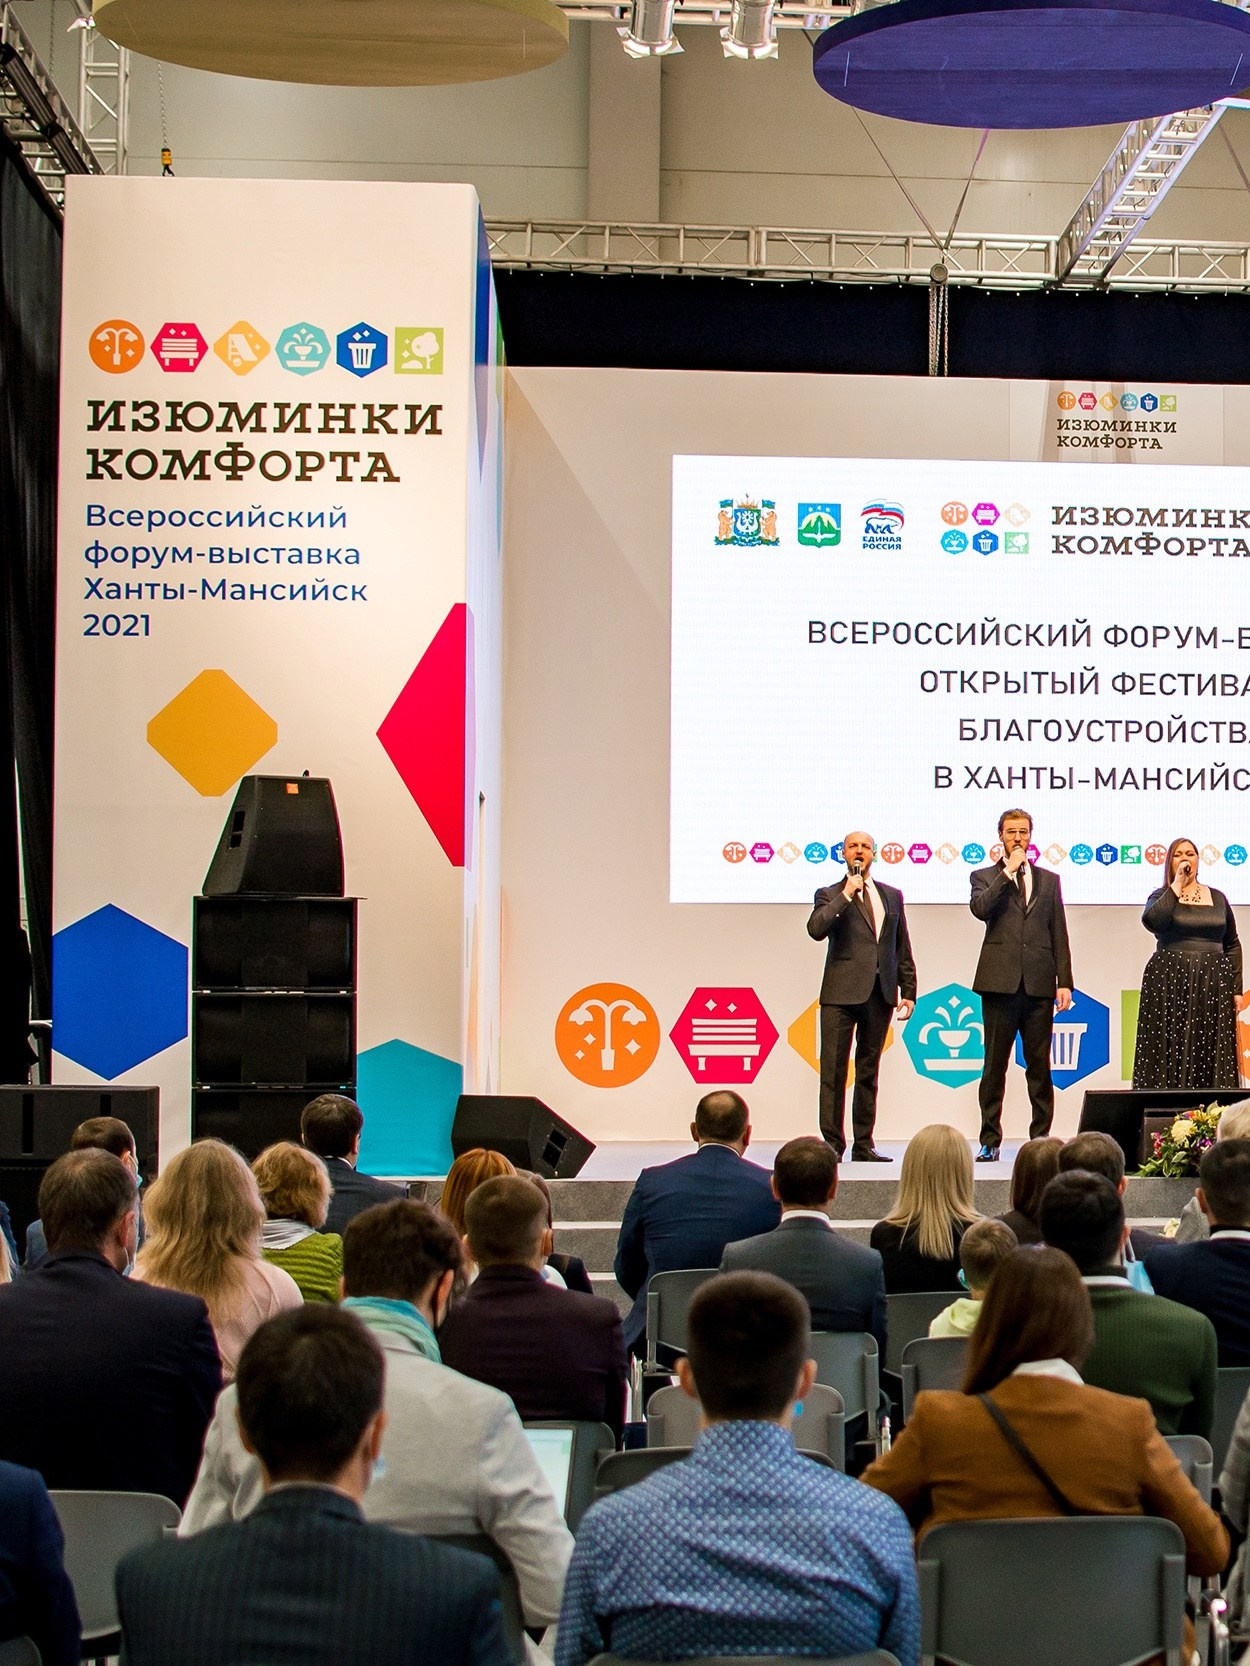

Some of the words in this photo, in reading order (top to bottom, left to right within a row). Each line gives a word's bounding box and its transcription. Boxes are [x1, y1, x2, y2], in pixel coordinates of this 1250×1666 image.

[86, 399, 443, 436] ИЗЮМИНКИ
[1056, 418, 1177, 434] ИЗЮМИНКИ
[1056, 433, 1164, 450] КОМФОРТА
[85, 441, 401, 483] КОМФОРТА
[86, 504, 346, 532] Всероссийский
[862, 535, 902, 543] ЕДИНАЯ
[862, 542, 902, 550] РОССИЯ
[84, 539, 360, 570] форум-выставка
[83, 577, 368, 601] Ханты-Мансийск
[83, 613, 150, 637] 2021
[808, 616, 1091, 648] ВСЕРОССИЙСКИЙ
[920, 665, 1099, 695] ОТКРЫТЫЙ
[934, 765, 953, 789] В
